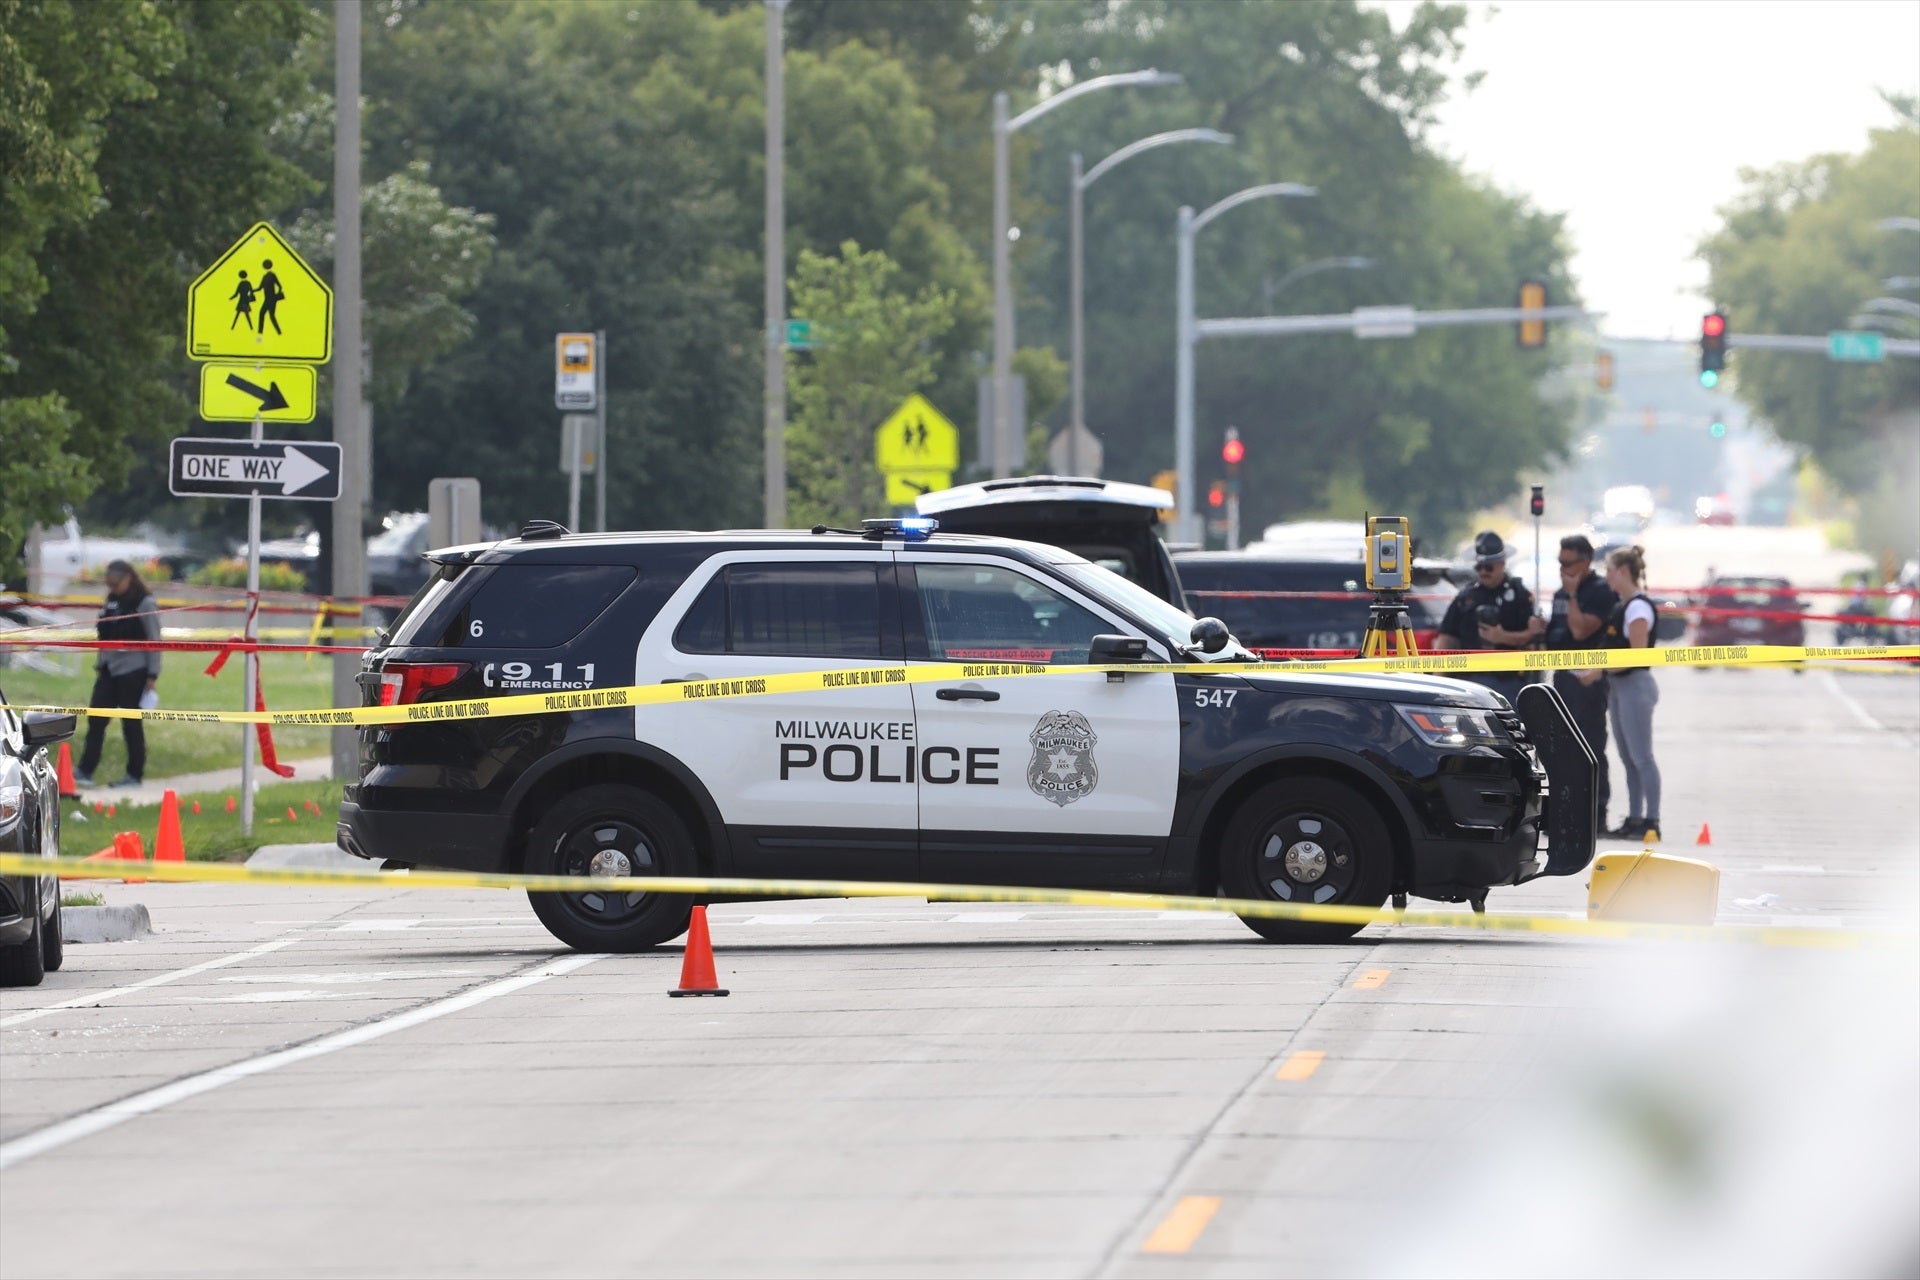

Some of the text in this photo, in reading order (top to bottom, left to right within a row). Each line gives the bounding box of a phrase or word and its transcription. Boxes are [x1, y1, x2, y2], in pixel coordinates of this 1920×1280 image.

[187, 458, 283, 480] ONE WAY
[470, 620, 484, 637] 6
[502, 662, 595, 681] 911
[823, 669, 906, 686] POLICE LINE DO NOT CROSS
[964, 666, 984, 676] POLICE
[986, 666, 1000, 676] LINE
[1001, 665, 1010, 674] DO
[1011, 665, 1024, 674] NOT
[500, 681, 593, 689] EMERGENCY
[684, 680, 766, 698] POLICE LINE DO NOT CROSS
[546, 691, 627, 710] POLICE LINE DO NOT CROSS
[1195, 689, 1238, 708] 547
[273, 712, 354, 724] POLICE LINE DO NOT CROSS
[408, 702, 490, 720] POLICE LINE DO NOT CROSS
[776, 720, 914, 740] MILWAUKEE
[1038, 738, 1088, 750] MILWAUKEE
[780, 744, 1000, 784] POLICE
[1040, 778, 1084, 791] POLICE
